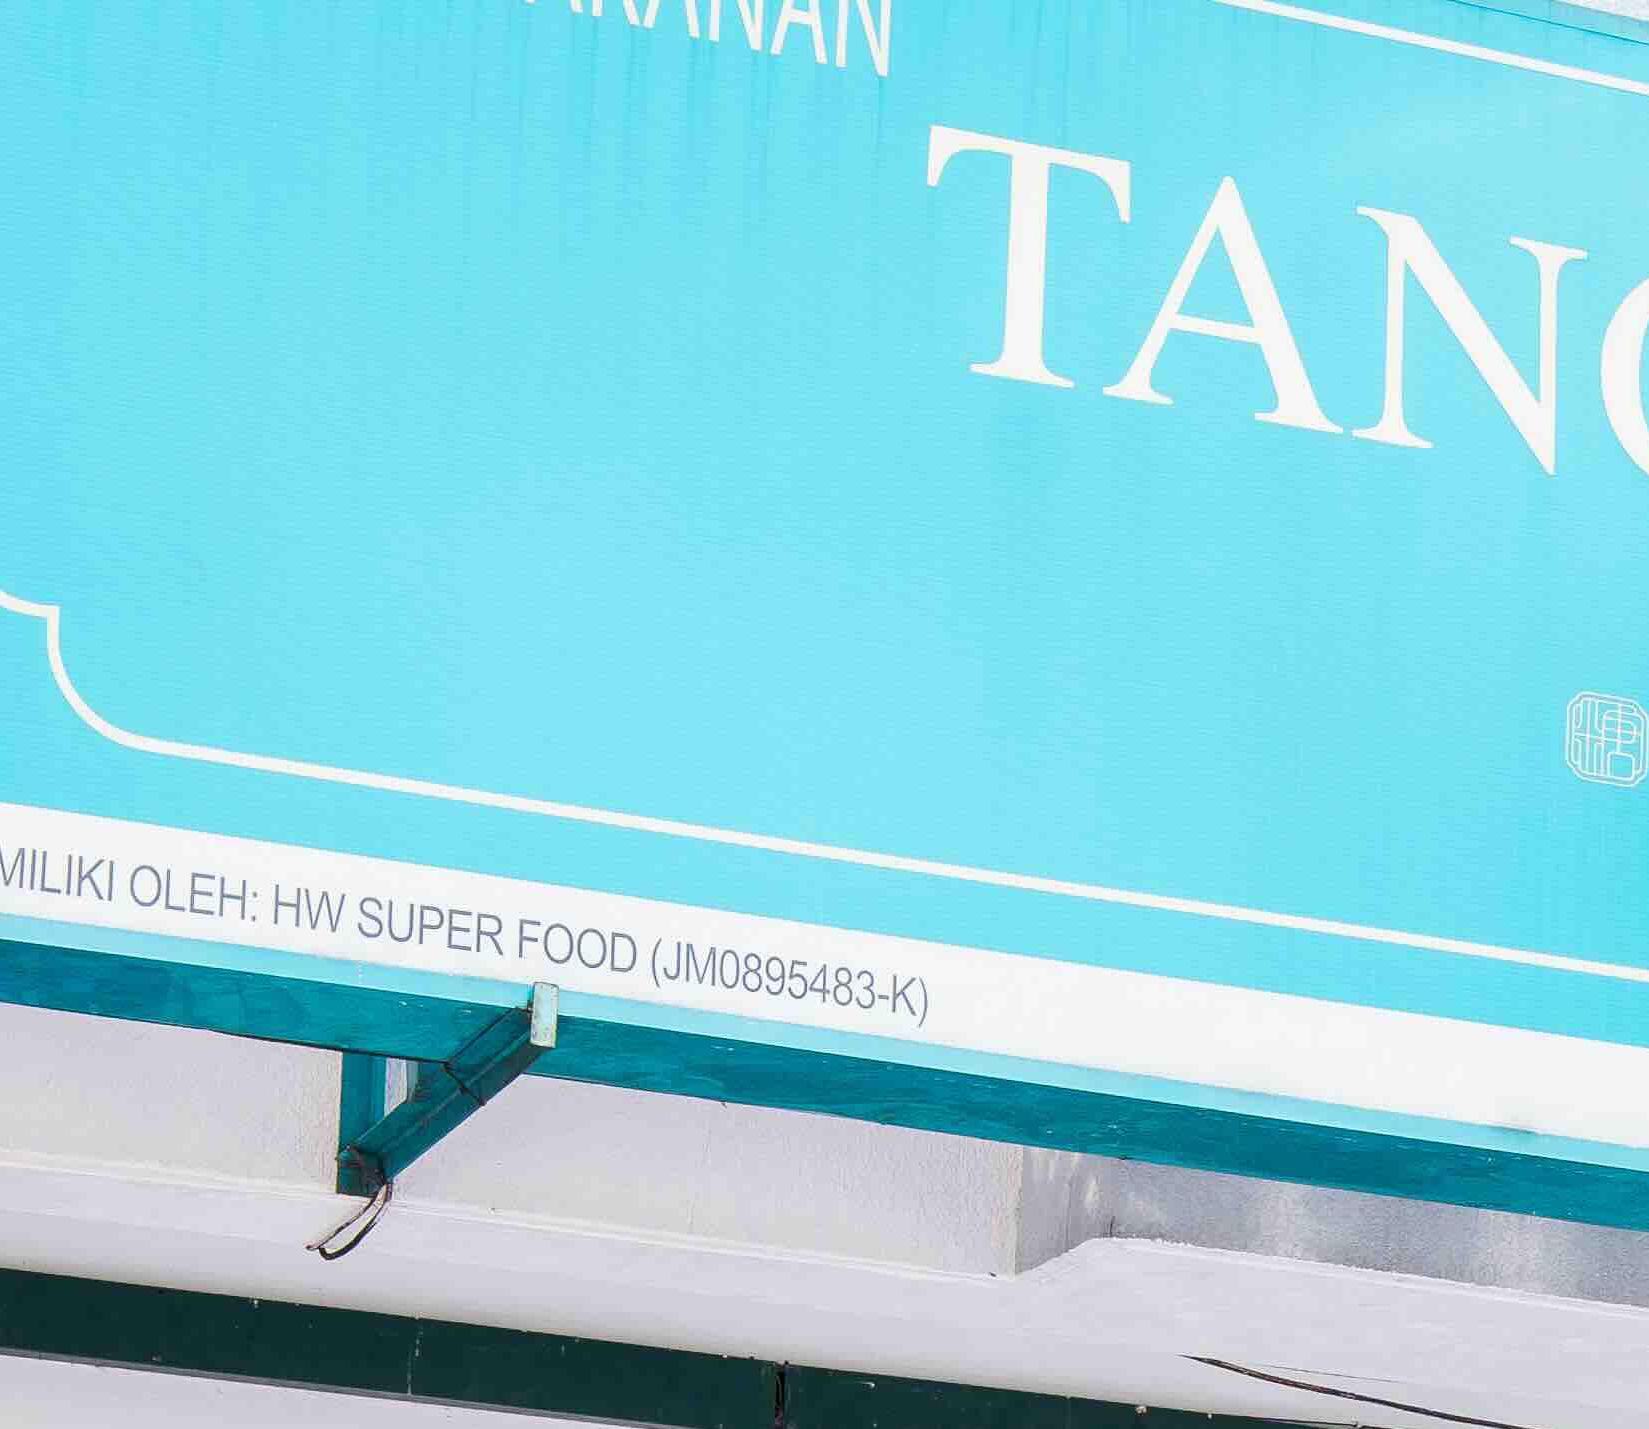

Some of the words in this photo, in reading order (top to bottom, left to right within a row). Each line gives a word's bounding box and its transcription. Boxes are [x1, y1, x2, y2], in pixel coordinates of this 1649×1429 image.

[129, 863, 262, 923] OLEH:
[272, 888, 347, 933] HW
[356, 896, 505, 958] SUPER
[516, 919, 639, 974] FOOD
[650, 939, 930, 1027] (JM0895483-K)
